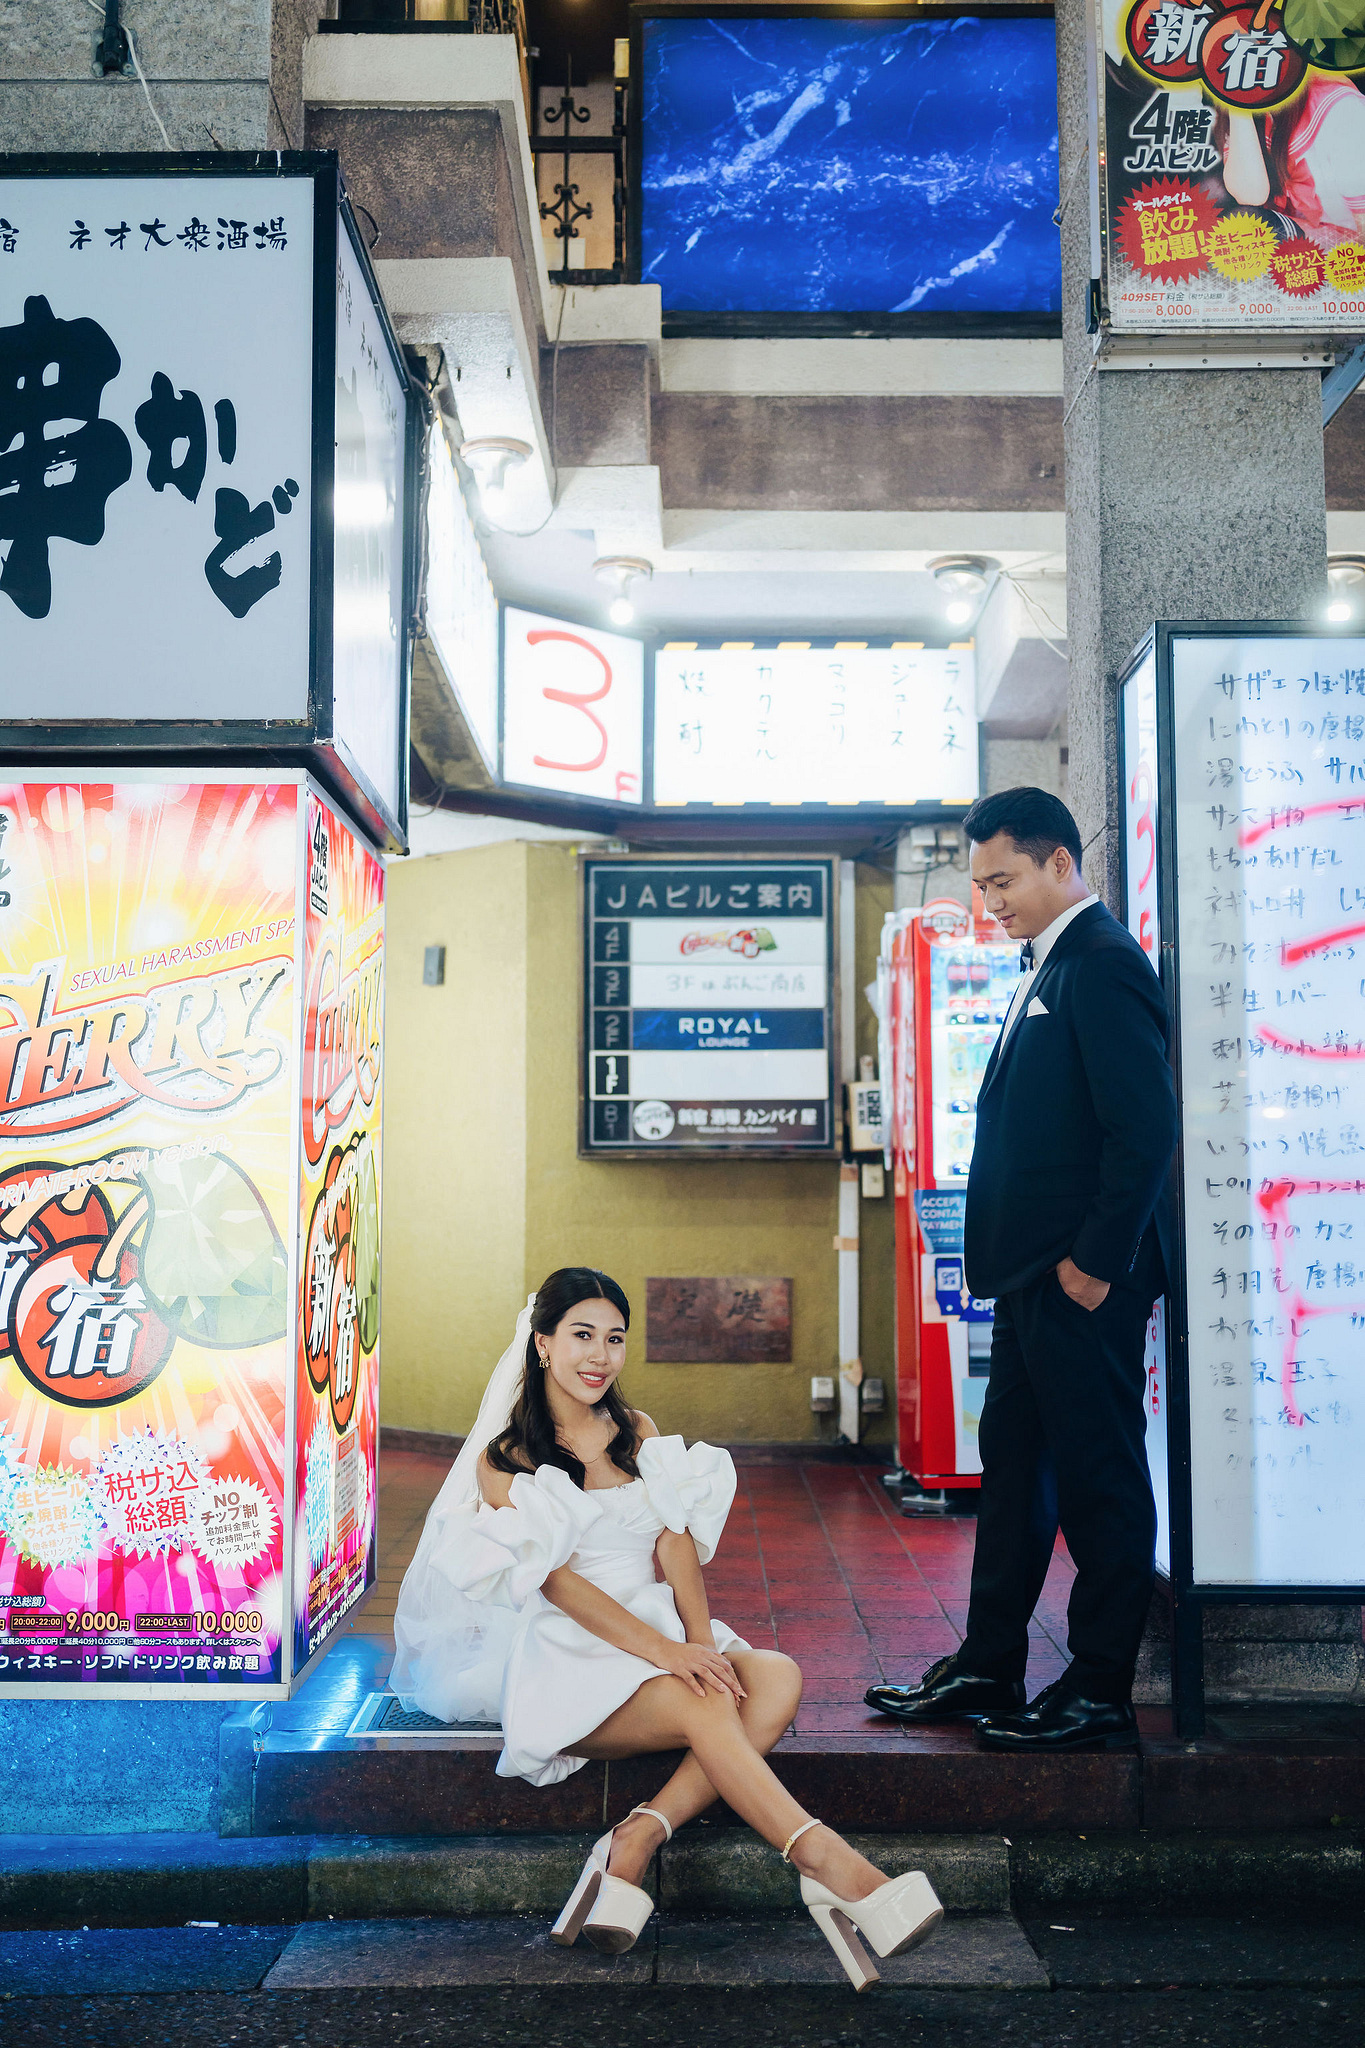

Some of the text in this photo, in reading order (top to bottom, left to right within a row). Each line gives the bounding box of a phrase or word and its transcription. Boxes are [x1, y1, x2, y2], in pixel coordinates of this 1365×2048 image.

[1142, 3, 1288, 90] 新宿
[1132, 91, 1213, 146] 4階
[1126, 148, 1220, 171] JAビル
[1132, 192, 1192, 212] オールタイム
[69, 216, 289, 252] ネオ大衆酒場
[1138, 206, 1199, 241] 飲み
[1214, 227, 1267, 247] 生ビール
[1272, 249, 1326, 274] 税サ込
[1337, 247, 1354, 258] NO
[1233, 260, 1262, 272] ドリンク
[1284, 266, 1320, 290] 総額
[756, 665, 778, 760] カクテル
[940, 660, 966, 754] ラムネ
[606, 882, 813, 910] JAビルご案内
[604, 927, 619, 959] 4F
[70, 959, 138, 992] SEXUAL
[141, 926, 265, 972] HARASSMENT
[604, 969, 619, 1004] 3F
[604, 1014, 619, 1048] 2F
[678, 1017, 769, 1034] ROYAL
[698, 1036, 750, 1048] LOUNGE
[605, 1055, 618, 1094] 1F
[307, 1235, 358, 1402] 新宿
[104, 1460, 200, 1505] 税サ込
[16, 1482, 86, 1510] 生ビール
[213, 1491, 241, 1509] NO
[36, 1504, 68, 1524] 焼酎
[124, 1495, 190, 1535] 総額
[200, 1502, 259, 1526] チップ制
[25, 1521, 82, 1539] ウィスキー
[205, 1519, 260, 1537] 追加料金無し
[206, 1529, 262, 1547] でお時間一杯
[13, 1617, 61, 1627] 20:00-22:00
[65, 1611, 130, 1633] 9,000円
[139, 1616, 189, 1628] 22:00-LAST
[193, 1611, 263, 1633] 10,000
